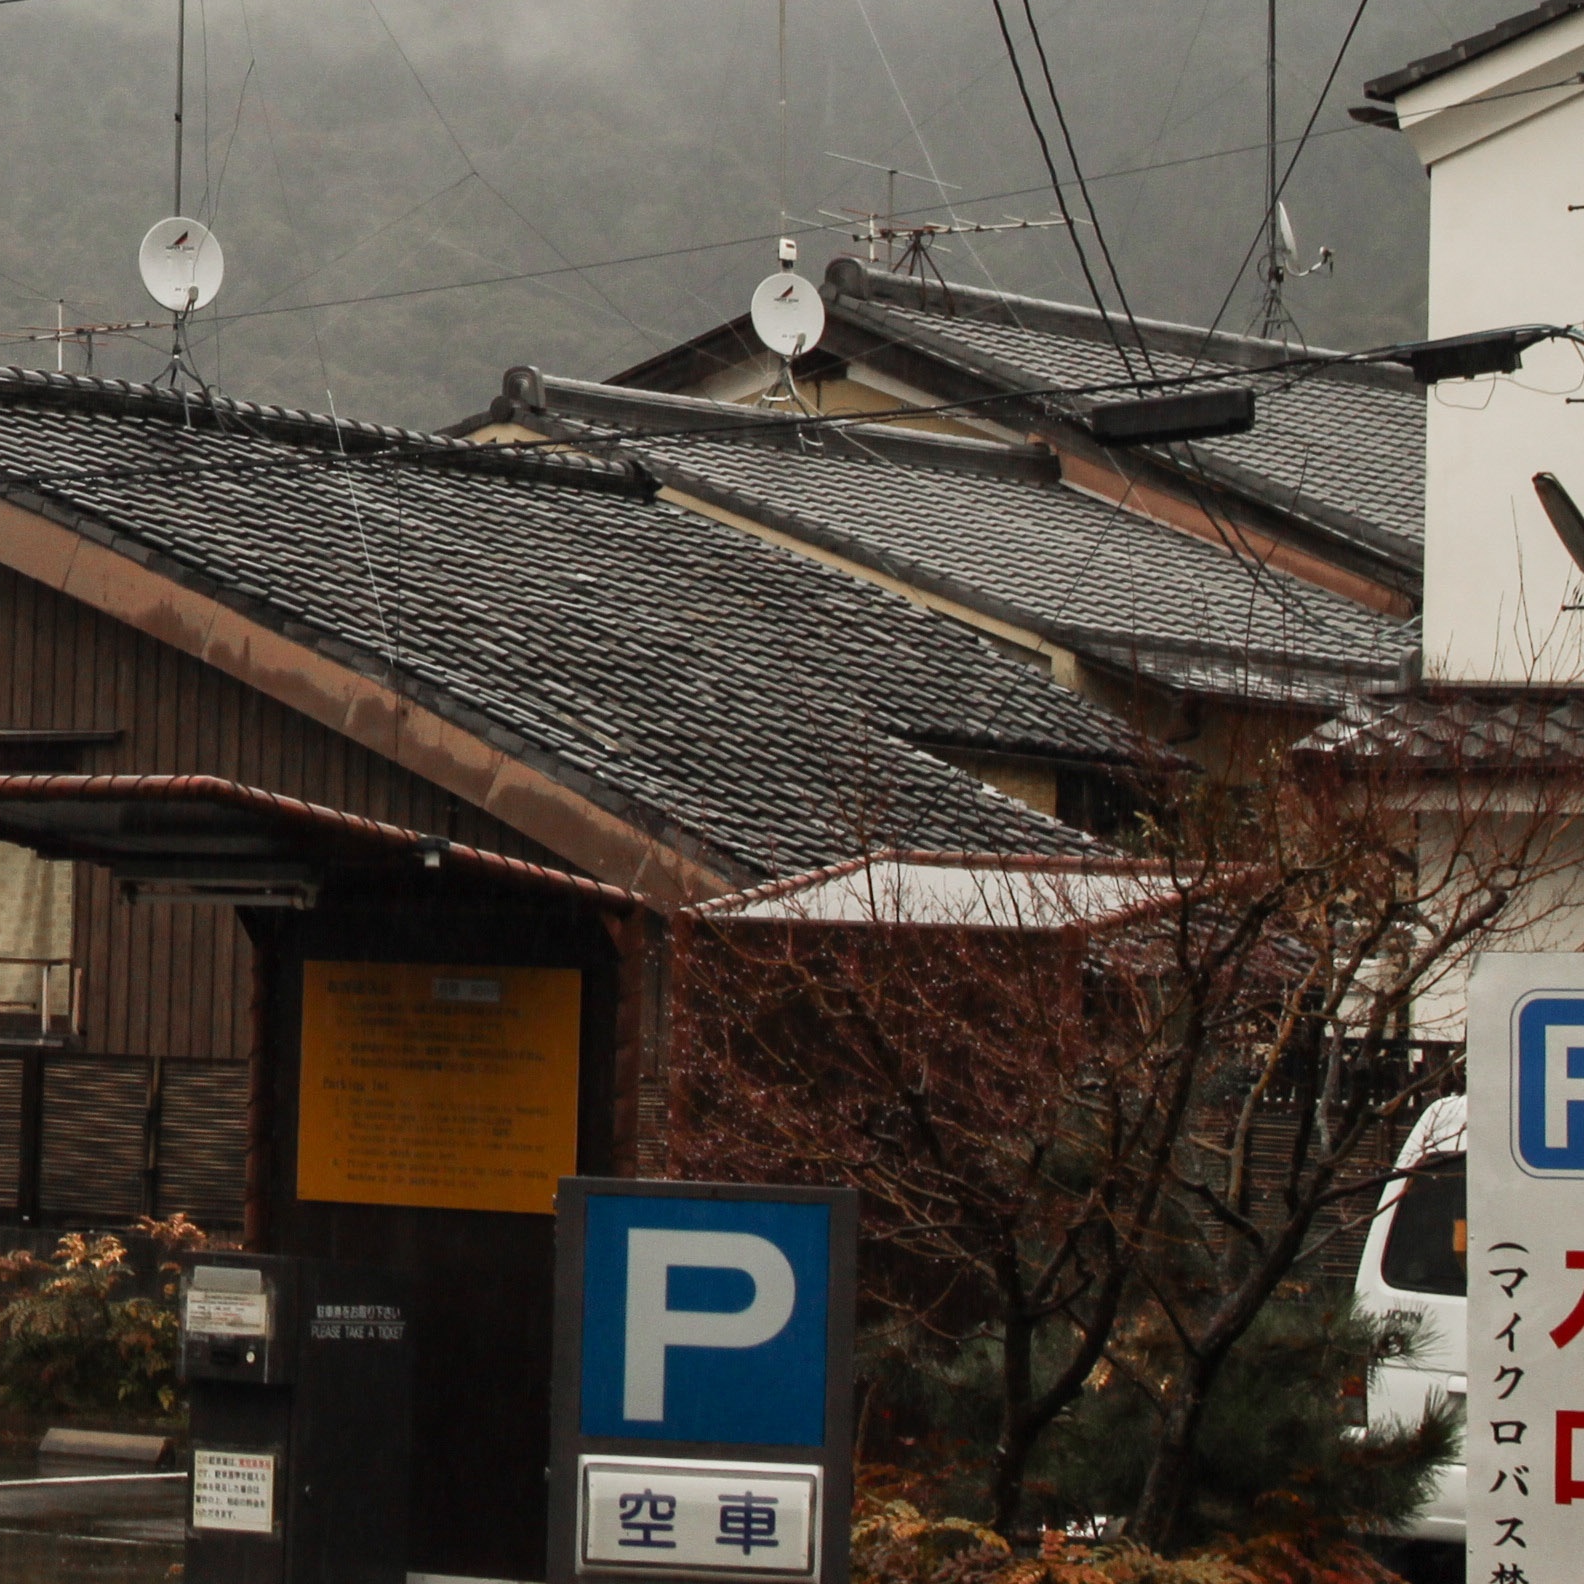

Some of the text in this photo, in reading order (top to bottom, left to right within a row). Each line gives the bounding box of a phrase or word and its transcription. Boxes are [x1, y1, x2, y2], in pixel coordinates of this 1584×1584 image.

[311, 1325, 341, 1339] PLEASE
[345, 1325, 365, 1339] TAKE
[378, 1325, 404, 1340] TICKET
[622, 1227, 796, 1422] P
[616, 1486, 781, 1558] 空車
